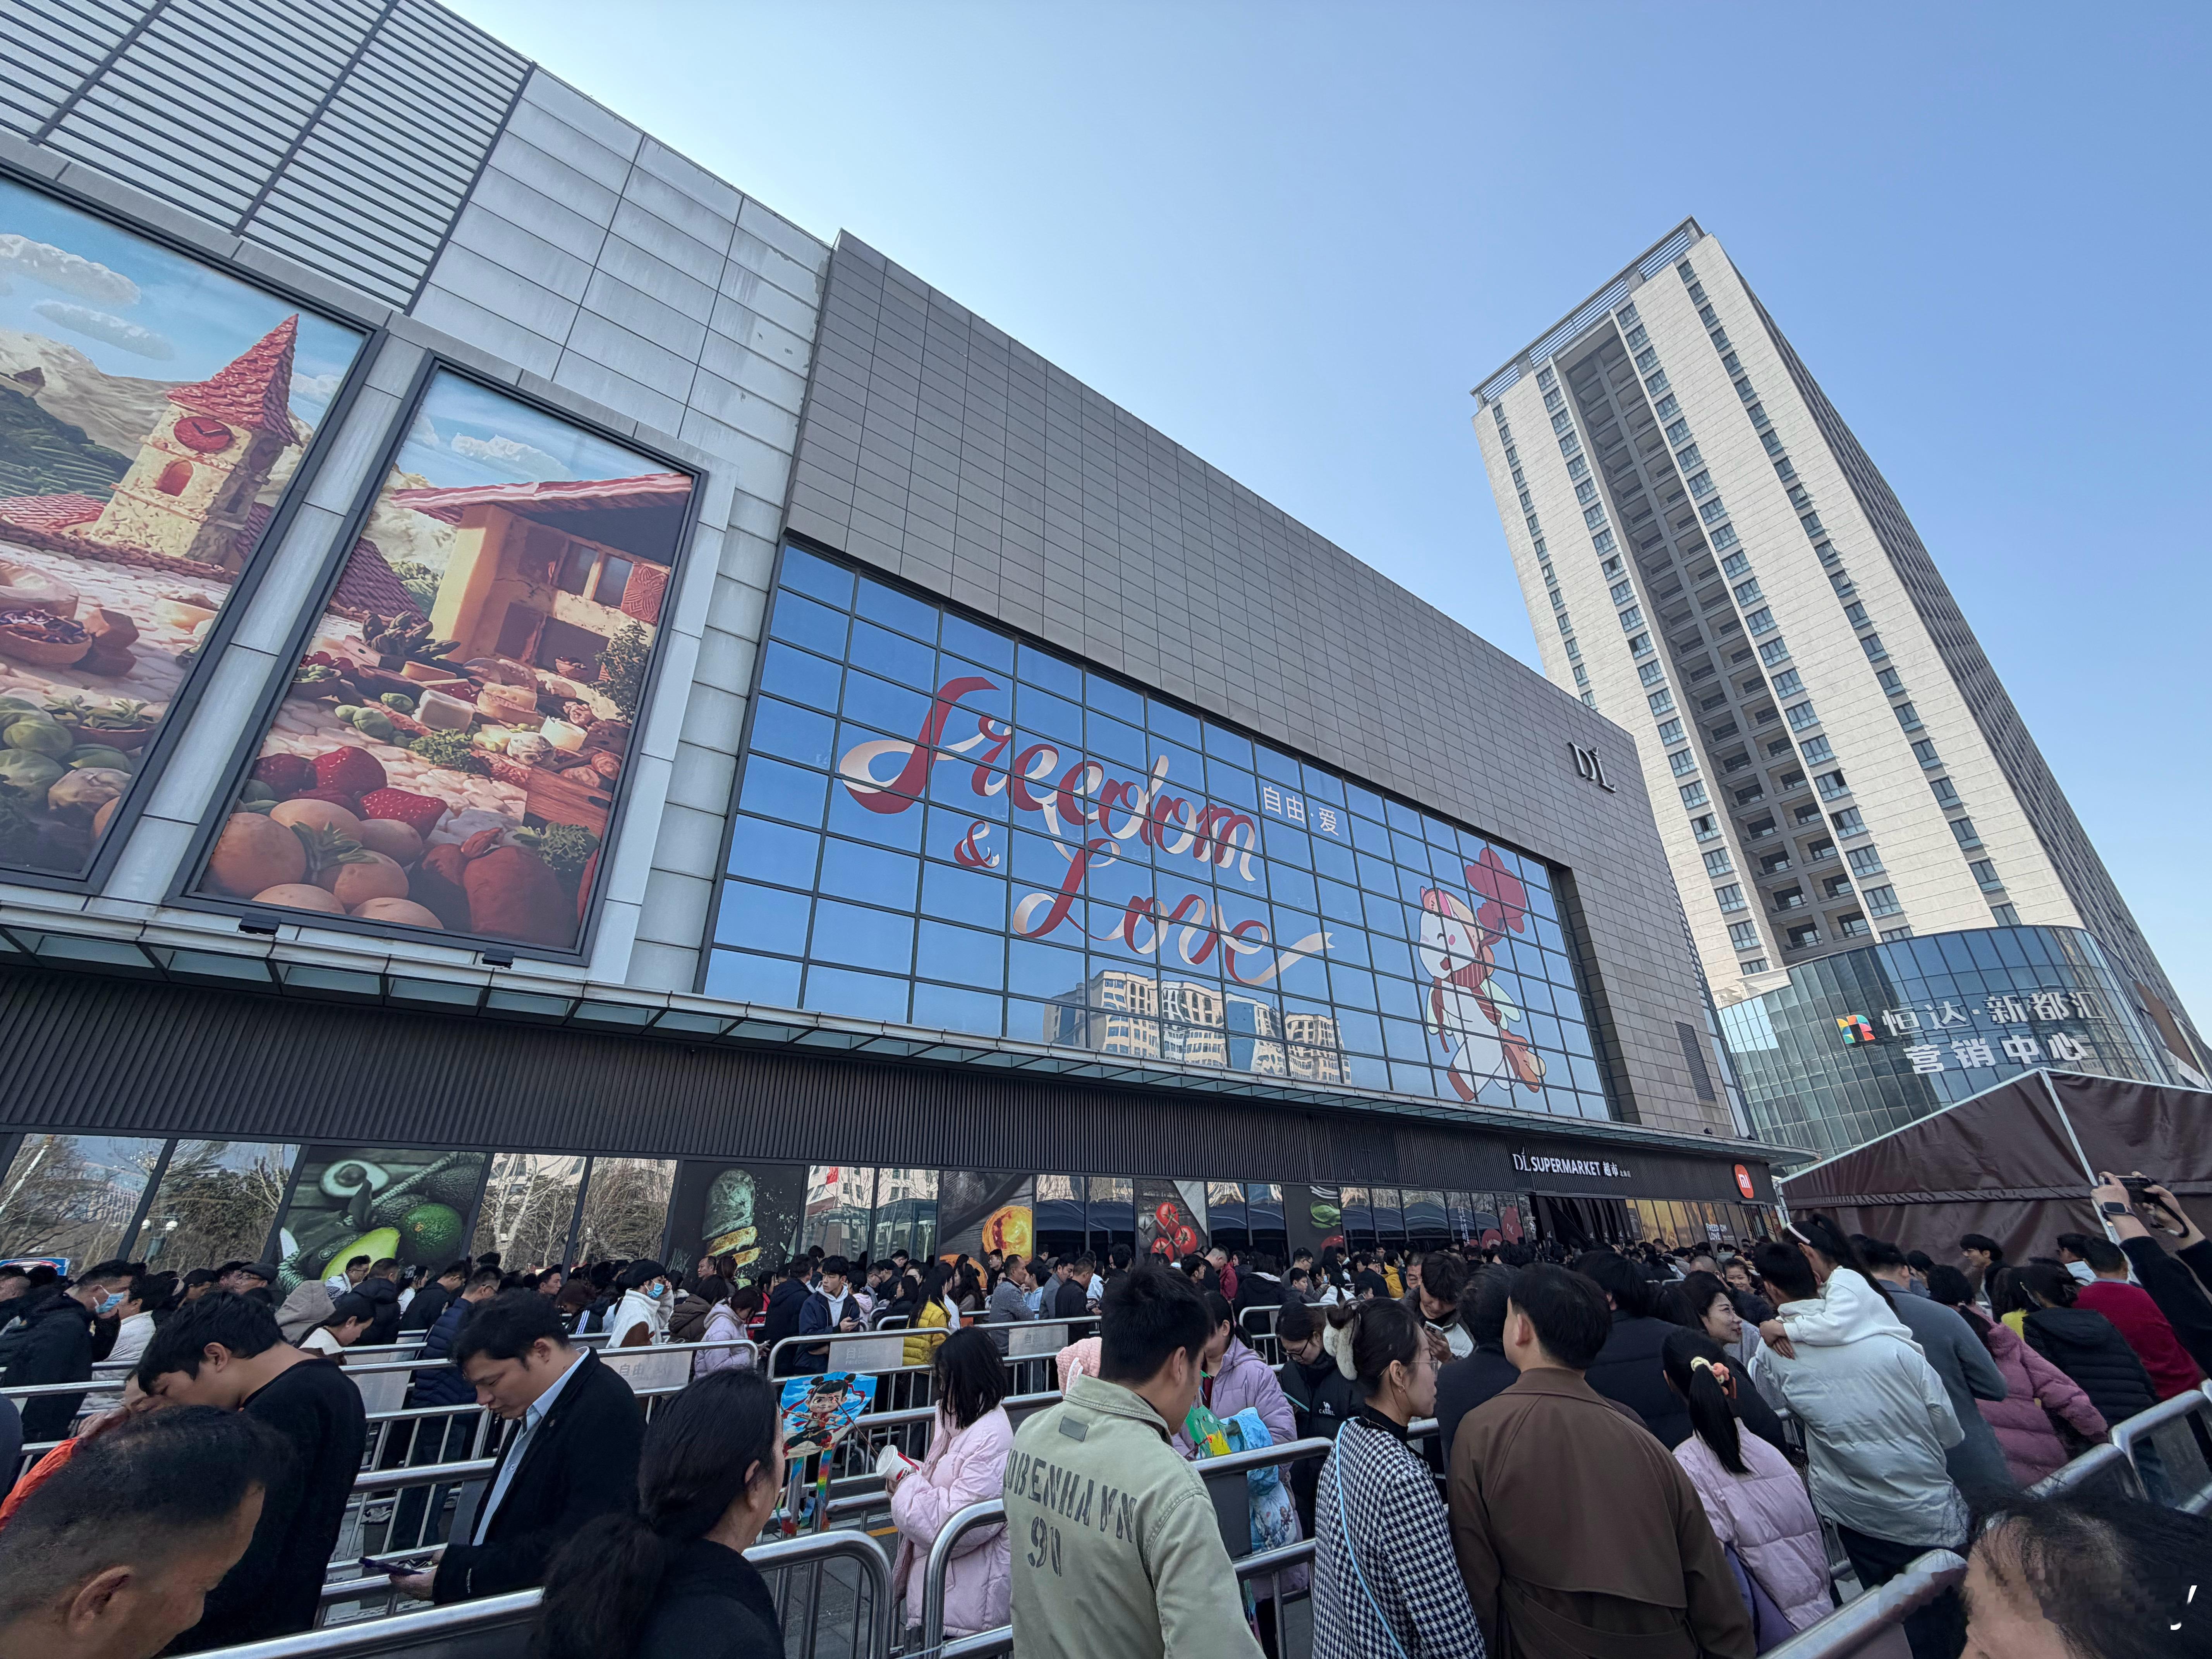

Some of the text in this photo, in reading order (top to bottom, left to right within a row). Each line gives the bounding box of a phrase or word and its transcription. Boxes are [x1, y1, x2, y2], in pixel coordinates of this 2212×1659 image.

[840, 677, 1256, 881] Freedom
[954, 821, 1334, 985] & Love
[1881, 991, 2108, 1036] 恒达·新都汇
[1903, 1032, 2088, 1075] 营销中心
[1530, 1156, 1601, 1176] SUPERMARKET
[1602, 1161, 1619, 1177] 超市
